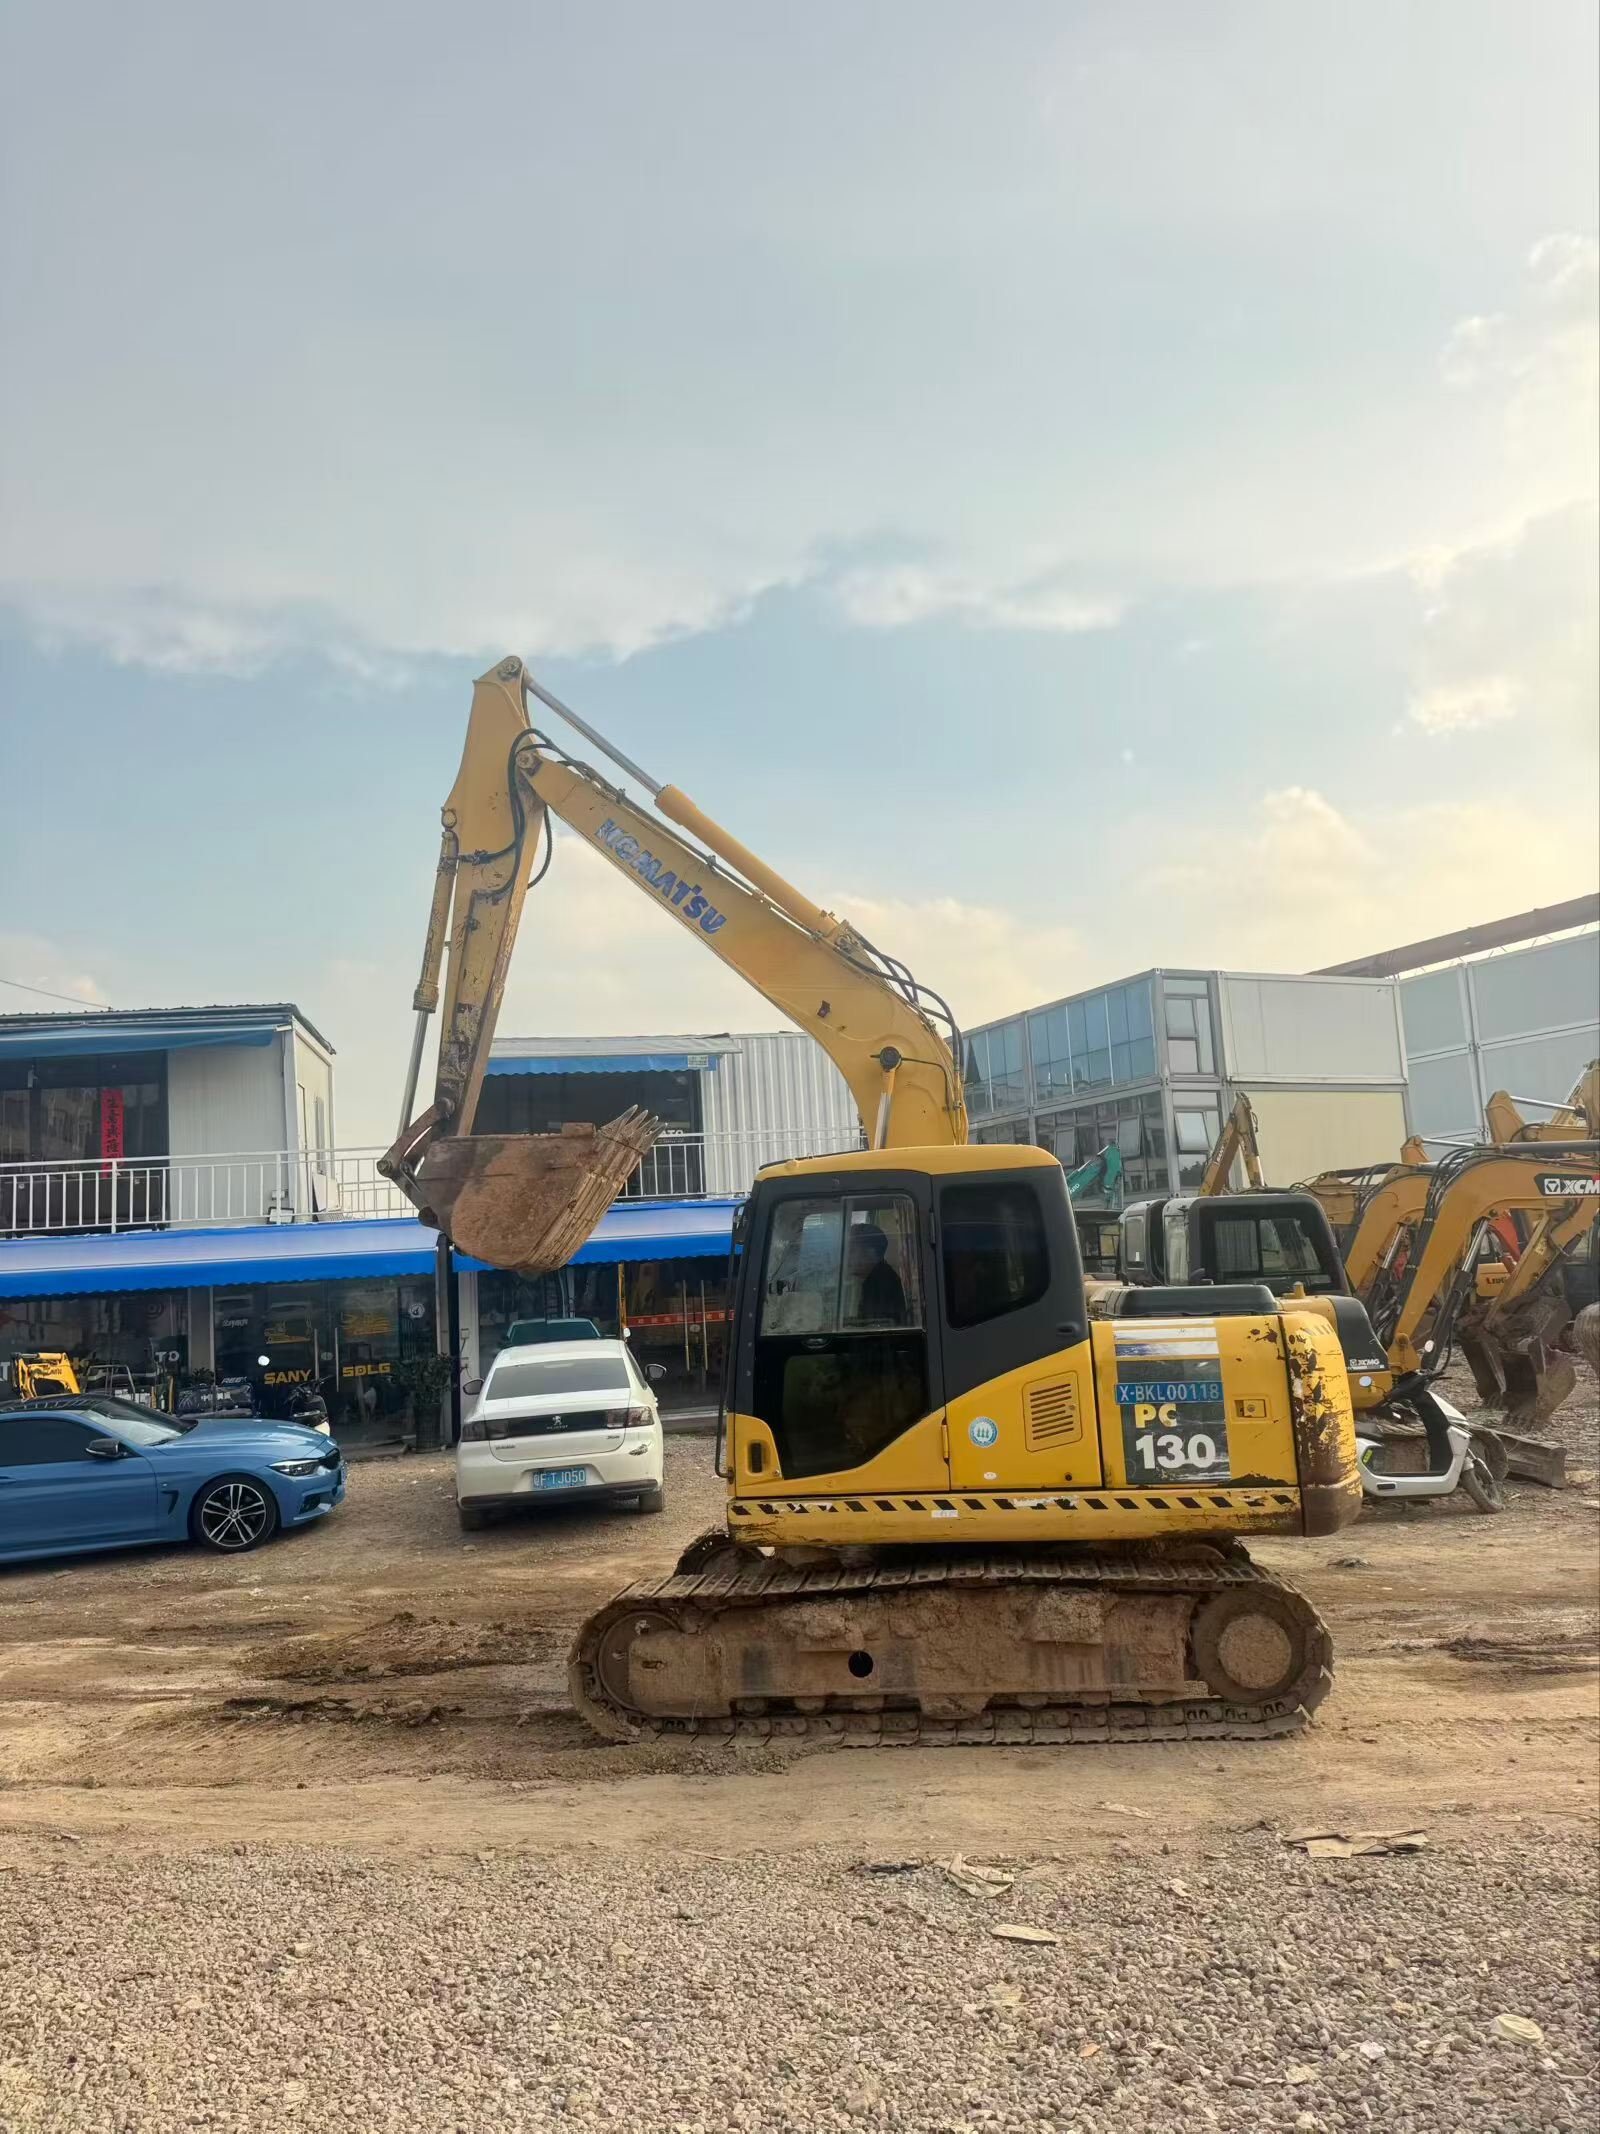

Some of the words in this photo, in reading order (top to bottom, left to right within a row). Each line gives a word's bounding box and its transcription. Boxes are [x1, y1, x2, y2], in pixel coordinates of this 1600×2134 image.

[595, 818, 727, 934] KOMATSU
[263, 1369, 313, 1385] SANY
[342, 1362, 391, 1378] SDLG
[1119, 1383, 1221, 1401] X-BKL00118
[1134, 1403, 1178, 1428] PC
[1135, 1432, 1217, 1470] 130
